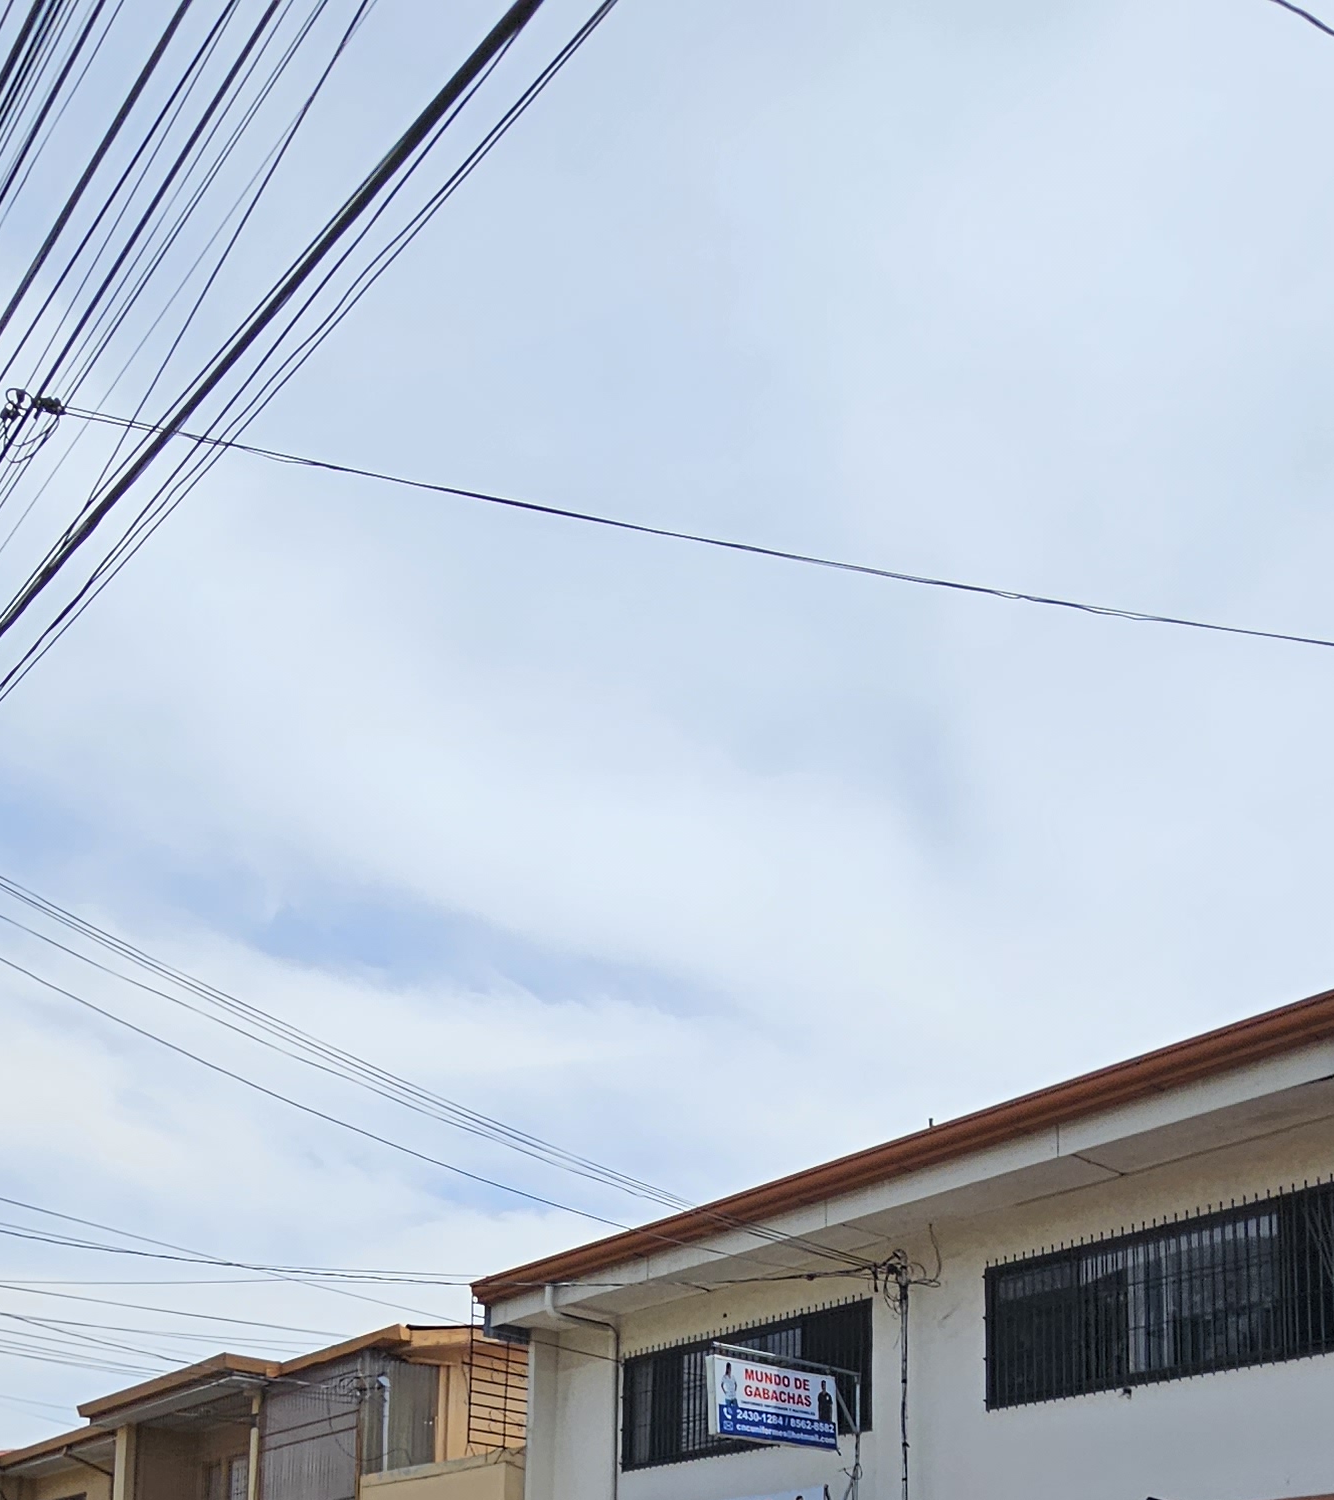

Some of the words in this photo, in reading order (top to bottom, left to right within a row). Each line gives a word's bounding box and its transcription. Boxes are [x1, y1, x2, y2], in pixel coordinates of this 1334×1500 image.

[744, 1368, 790, 1388] MUNDO
[794, 1377, 810, 1391] DE
[744, 1385, 812, 1407] GABACHAS
[736, 1409, 783, 1425] 2430-1284
